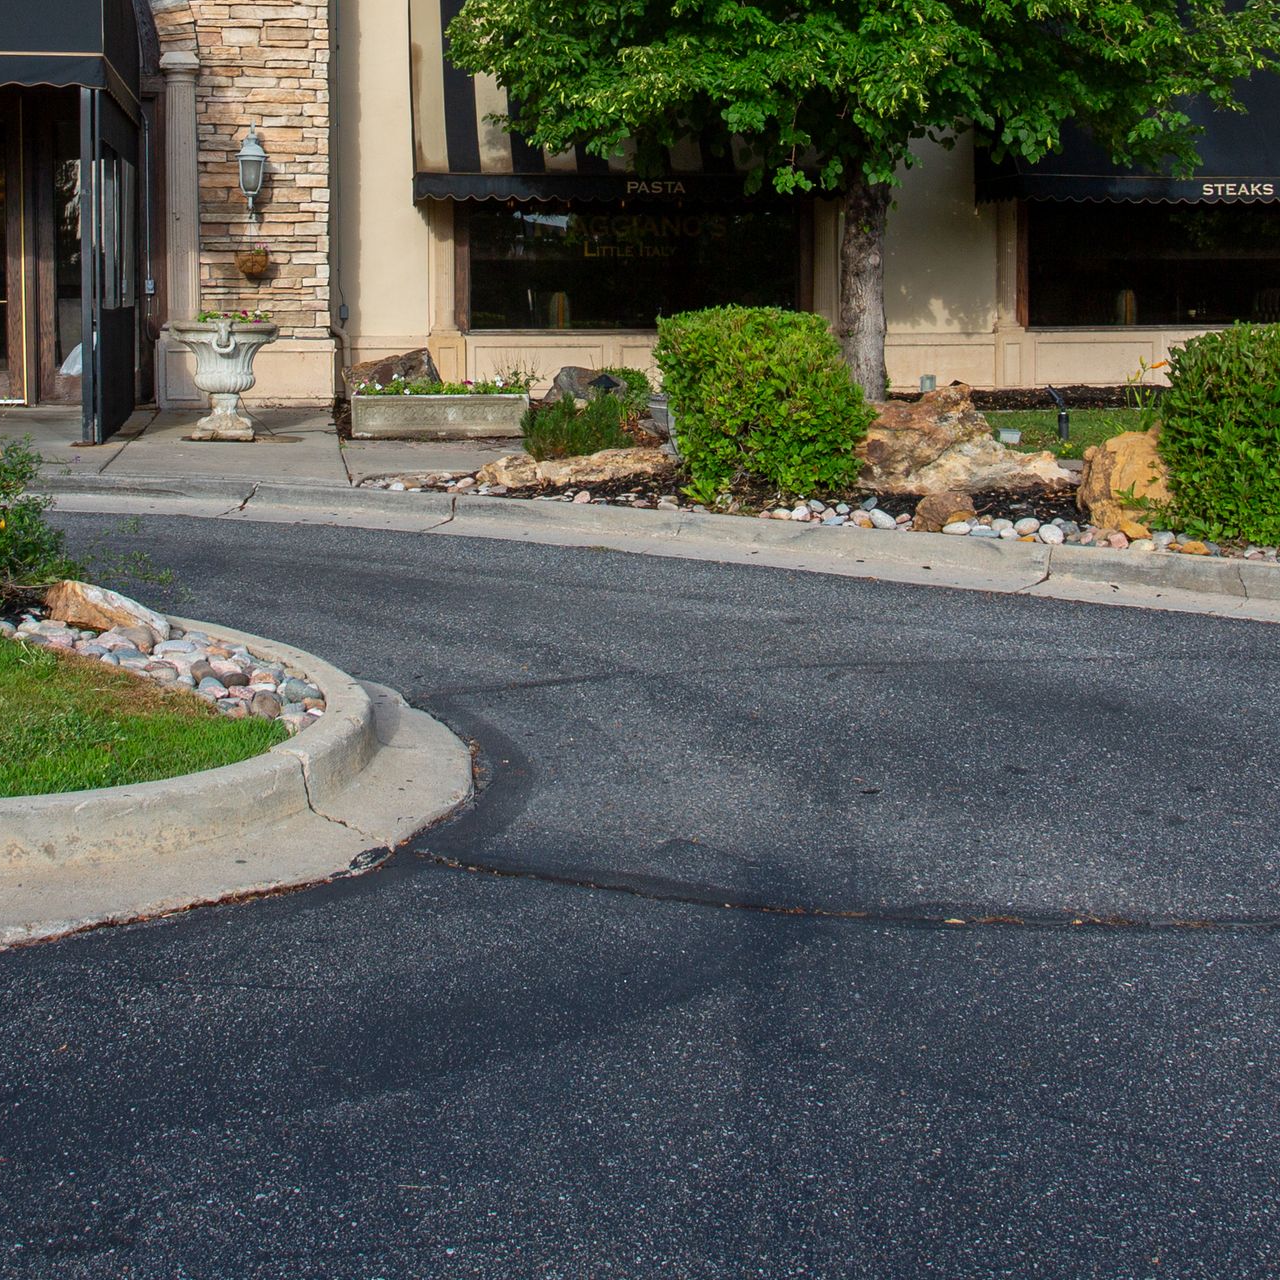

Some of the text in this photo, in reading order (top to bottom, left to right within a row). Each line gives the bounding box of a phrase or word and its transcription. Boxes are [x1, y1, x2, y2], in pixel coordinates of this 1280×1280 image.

[626, 181, 686, 194] PASTA
[1202, 183, 1274, 196] STEAKS
[584, 240, 678, 257] LITTLE ITALY
